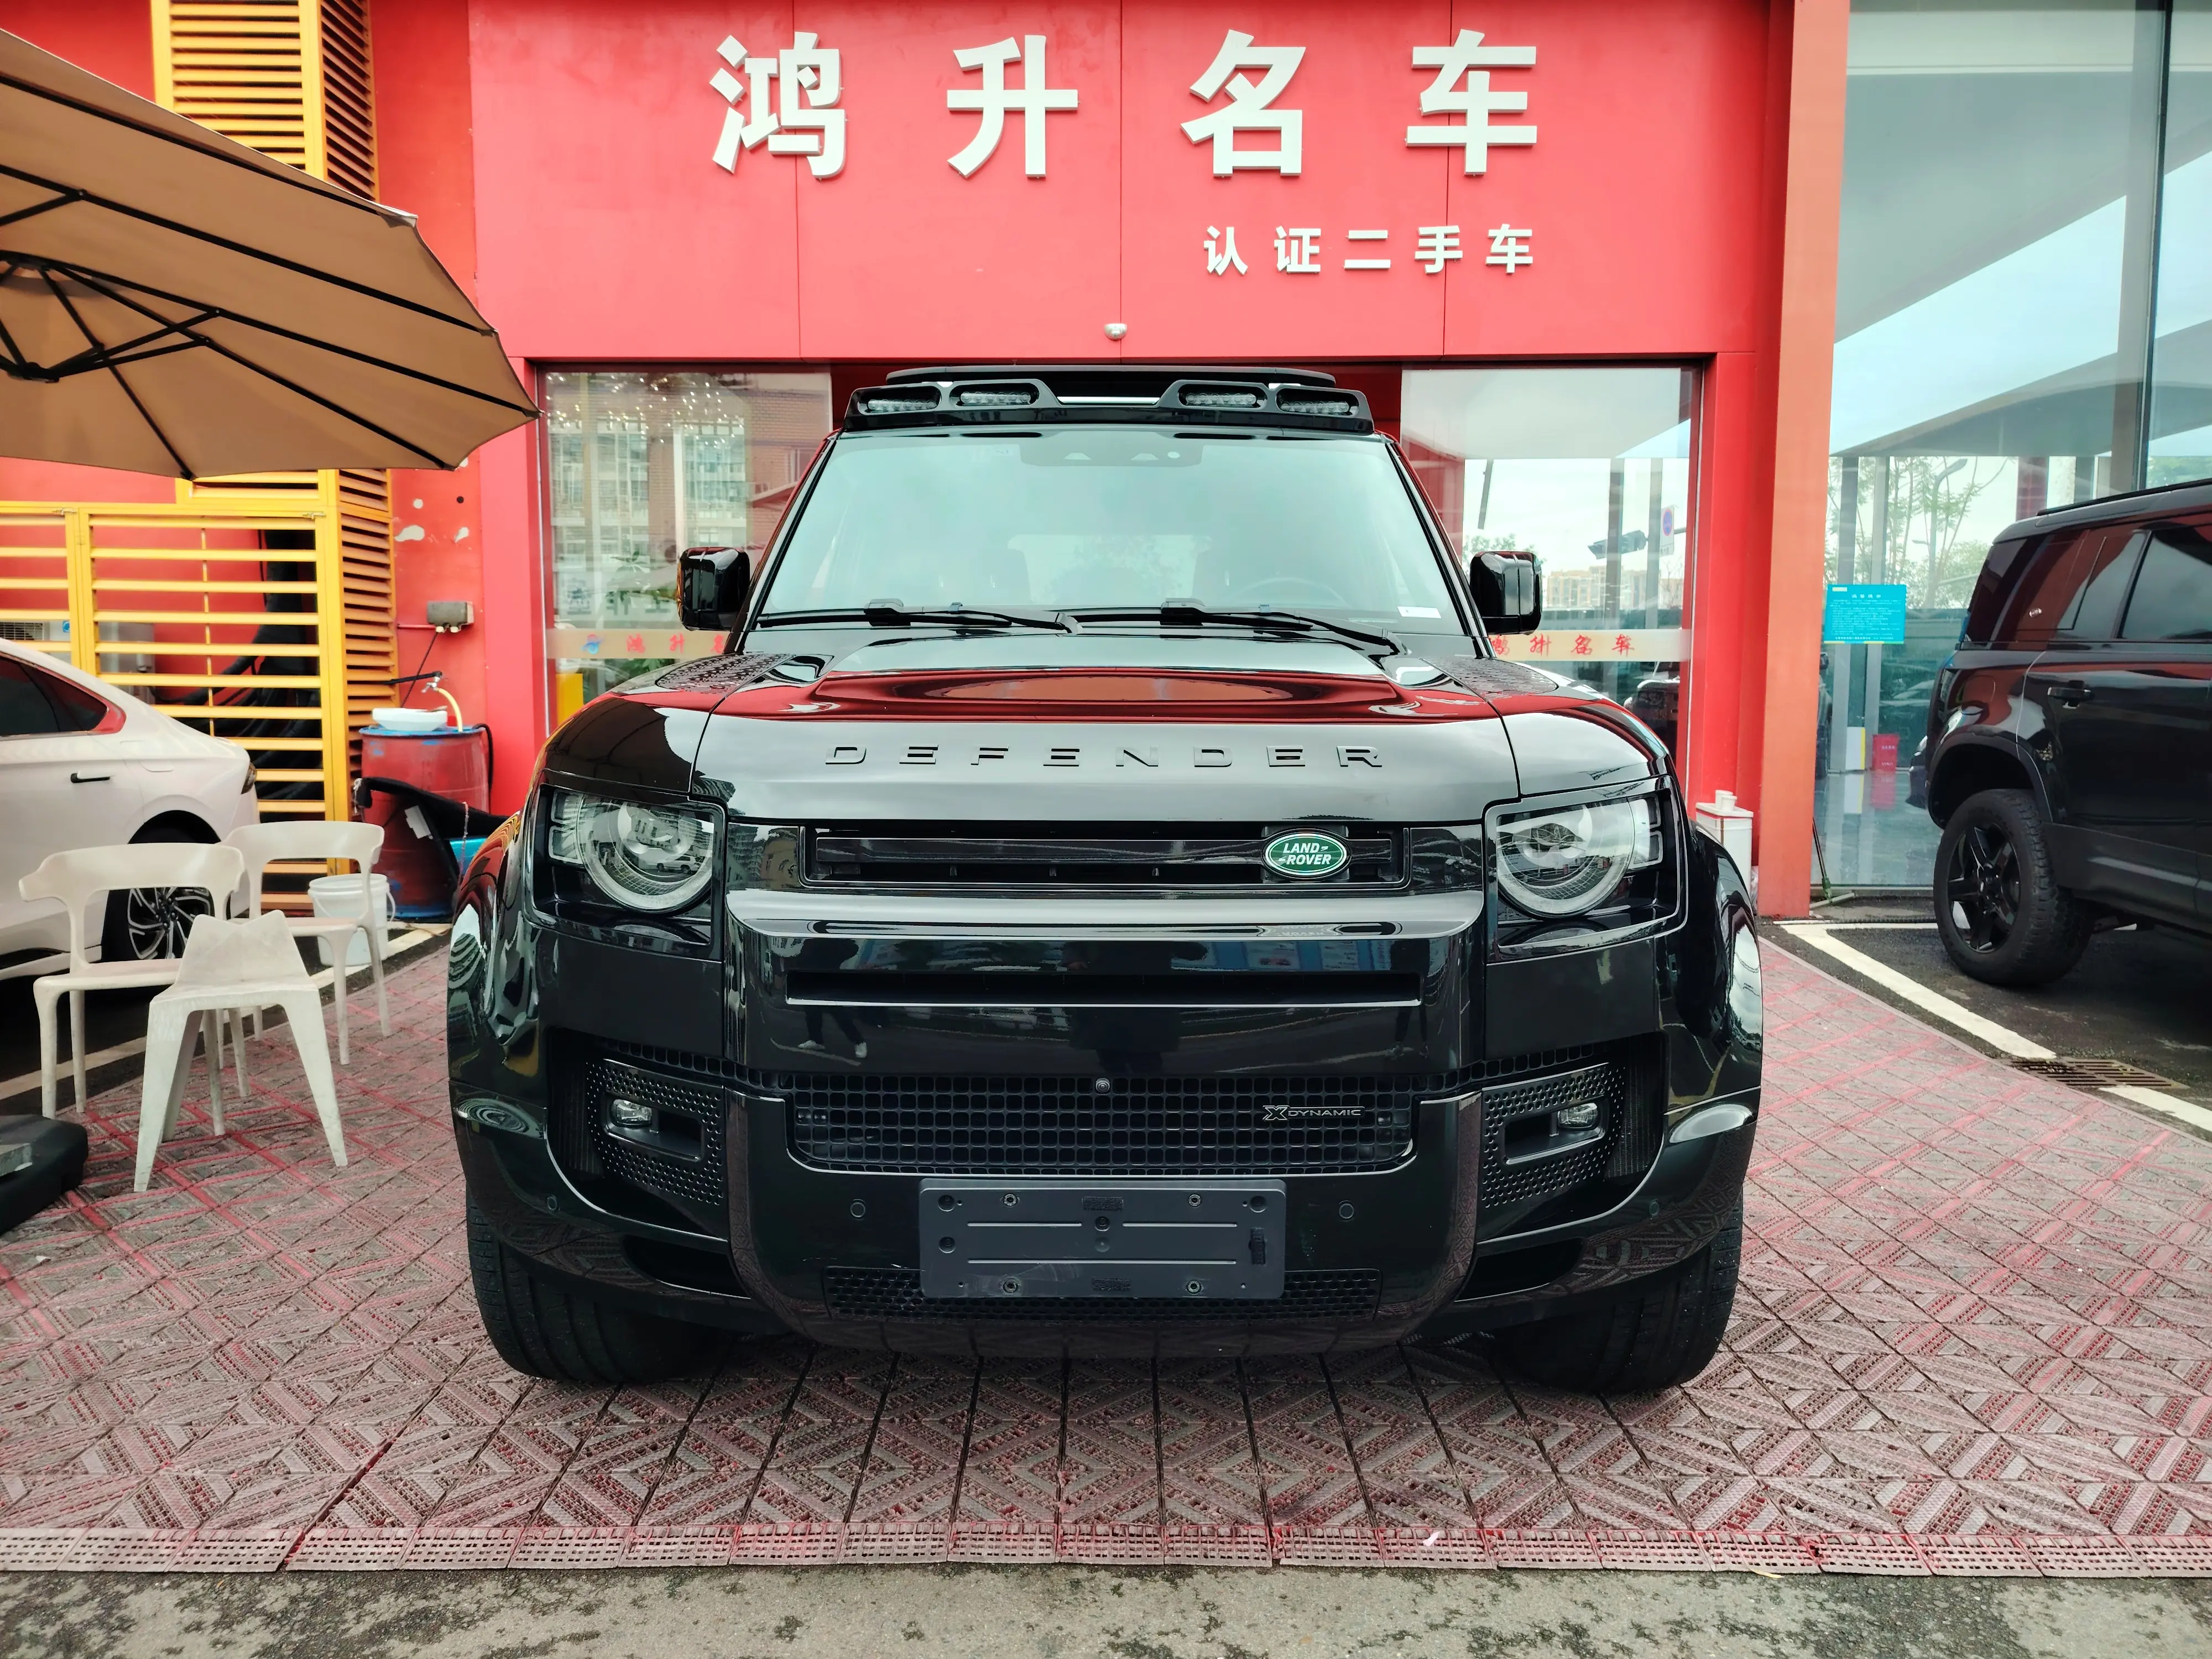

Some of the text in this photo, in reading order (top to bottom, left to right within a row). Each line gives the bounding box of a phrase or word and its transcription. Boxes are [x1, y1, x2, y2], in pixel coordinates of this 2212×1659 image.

[709, 29, 1538, 180] 鸿升名车
[1204, 223, 1535, 276] 认证二手车
[825, 743, 1384, 769] DEFENDER
[1282, 842, 1320, 853] LAND
[1286, 854, 1332, 865] ROVER
